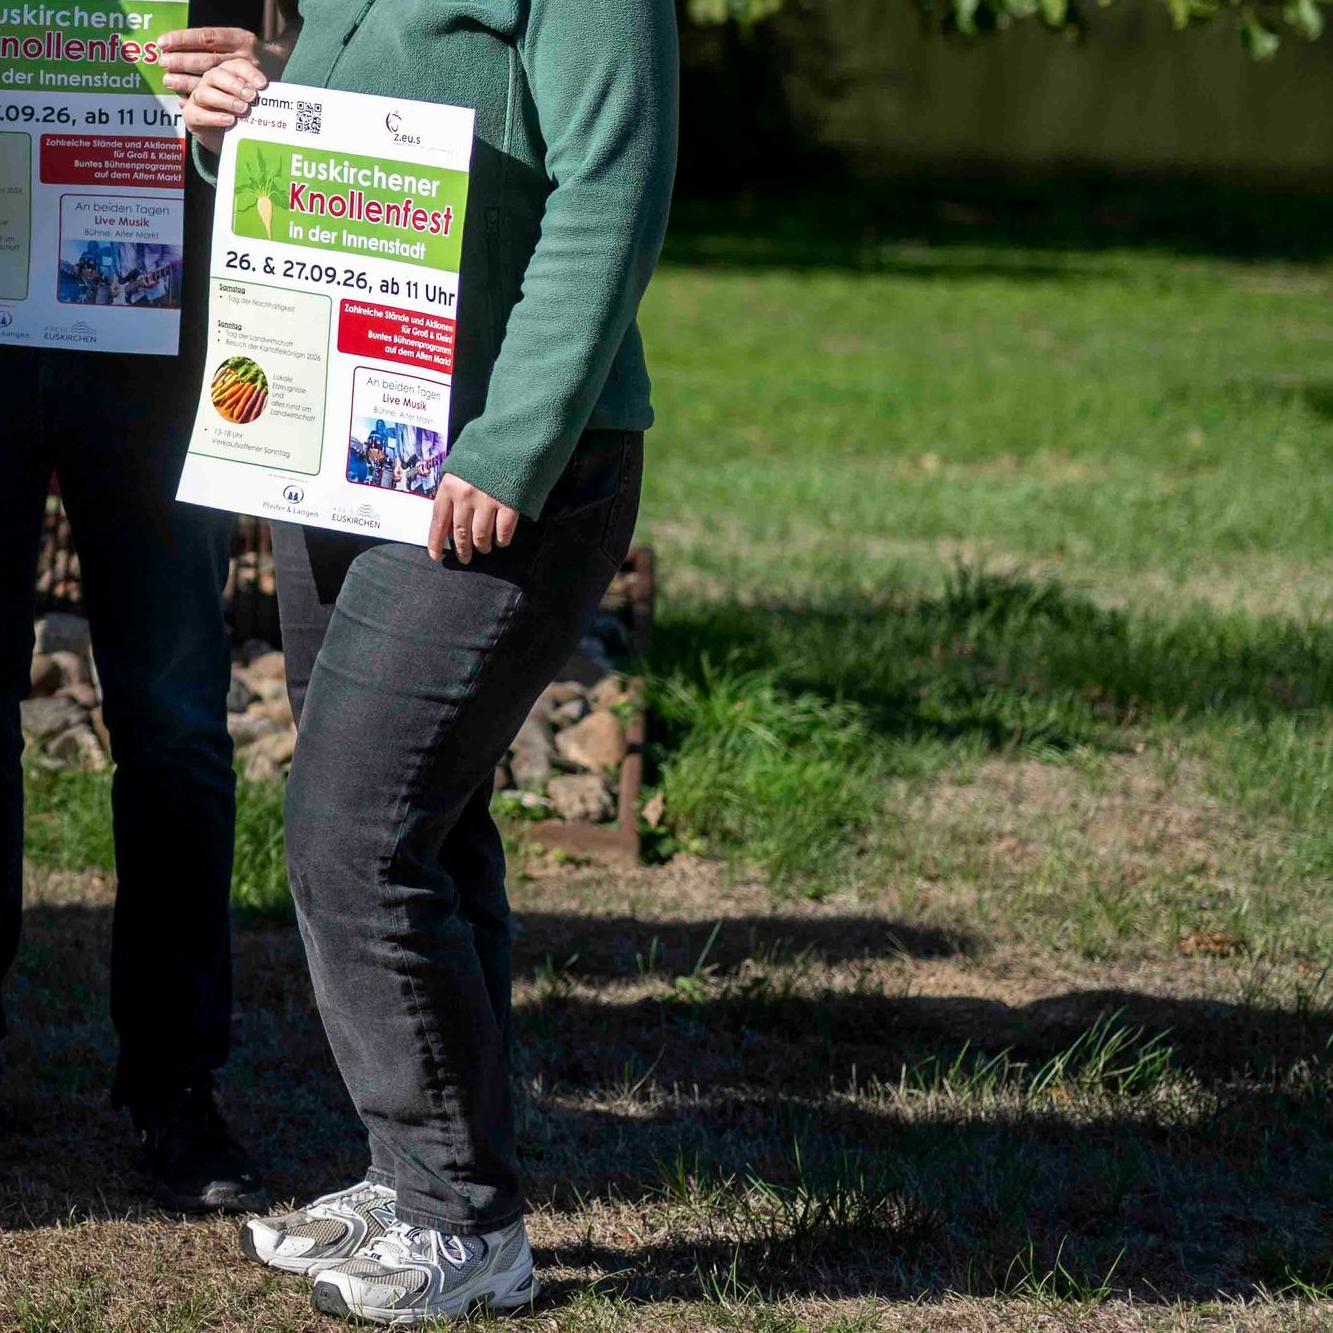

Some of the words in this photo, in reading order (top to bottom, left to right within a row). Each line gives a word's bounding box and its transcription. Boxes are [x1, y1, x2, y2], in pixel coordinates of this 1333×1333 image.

[2, 67, 32, 84] der
[39, 68, 141, 88] Innenstadt
[85, 108, 109, 124] ab
[117, 109, 132, 125] 11
[143, 109, 182, 128] Uhr
[393, 132, 420, 145] z.eu.s
[291, 153, 440, 199] Euskirchener
[288, 179, 452, 238] Knollenfest
[94, 215, 115, 225] Live
[118, 216, 149, 226] Musik
[289, 221, 303, 239] in
[309, 224, 336, 244] der
[341, 228, 427, 260] Innenstadt
[226, 250, 256, 272] 26.
[262, 257, 275, 275] &
[282, 259, 372, 293] 27.09.26,
[379, 275, 400, 296] ab
[406, 280, 419, 299] 11
[426, 283, 453, 308] Uhr
[382, 392, 401, 405] Live
[402, 397, 426, 411] Musik
